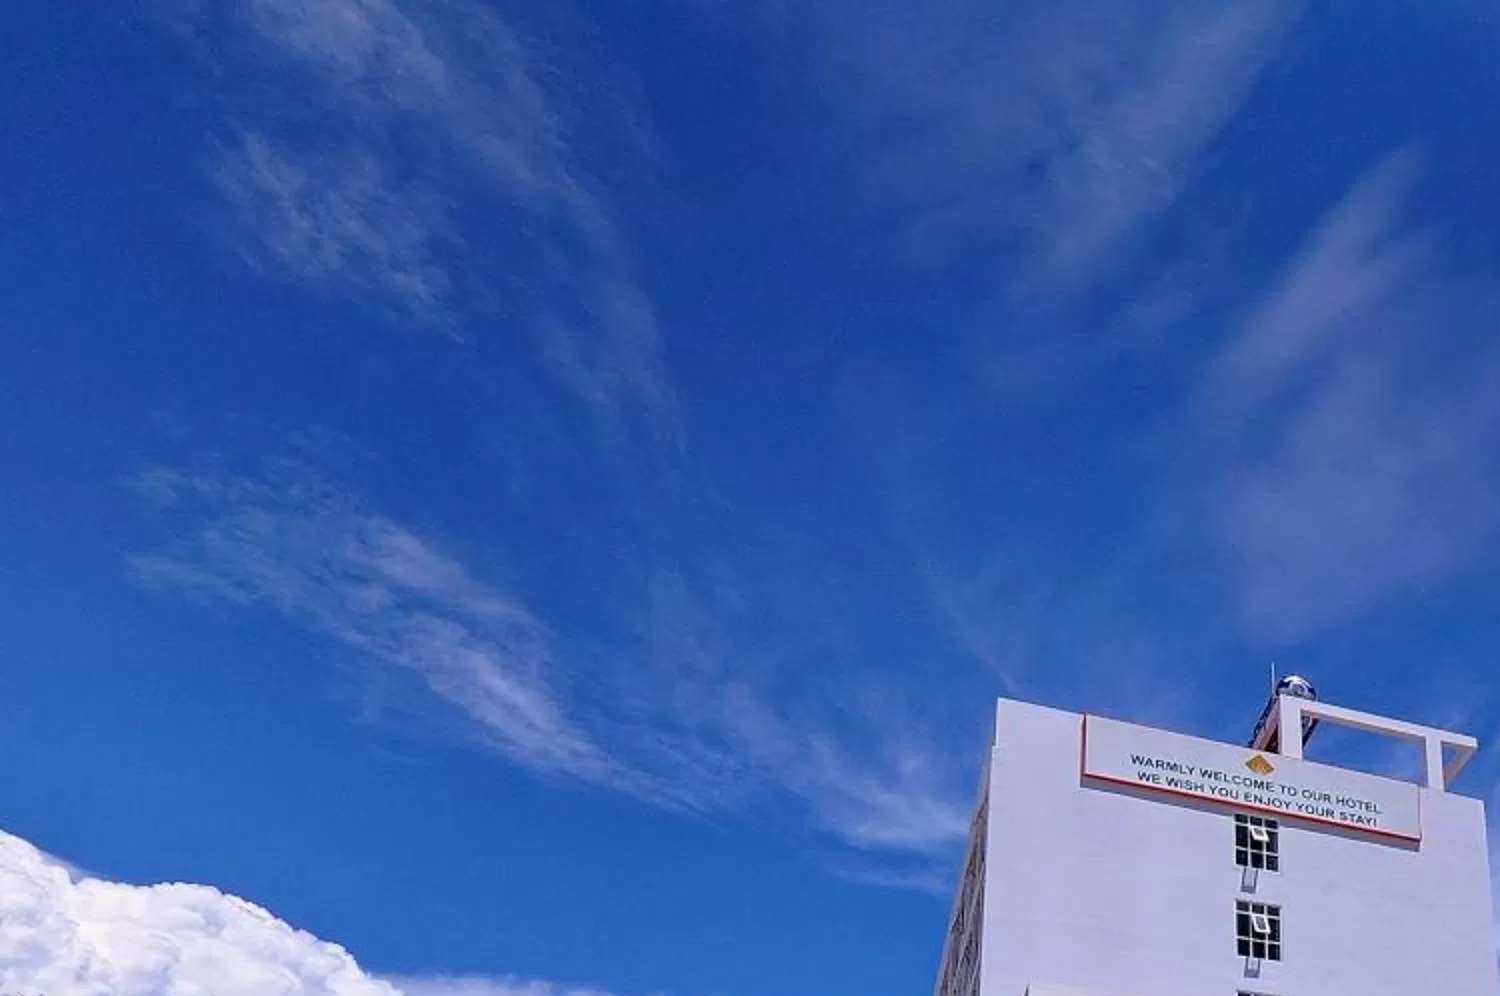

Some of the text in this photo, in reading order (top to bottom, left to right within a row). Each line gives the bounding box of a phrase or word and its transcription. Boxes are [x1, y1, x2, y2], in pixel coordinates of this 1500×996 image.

[1130, 753, 1382, 814] WARMLY WELCOME TO OUR HOTEL
[1137, 771, 1377, 827] WE WISH YOU ENJOY YOUR STAY!
